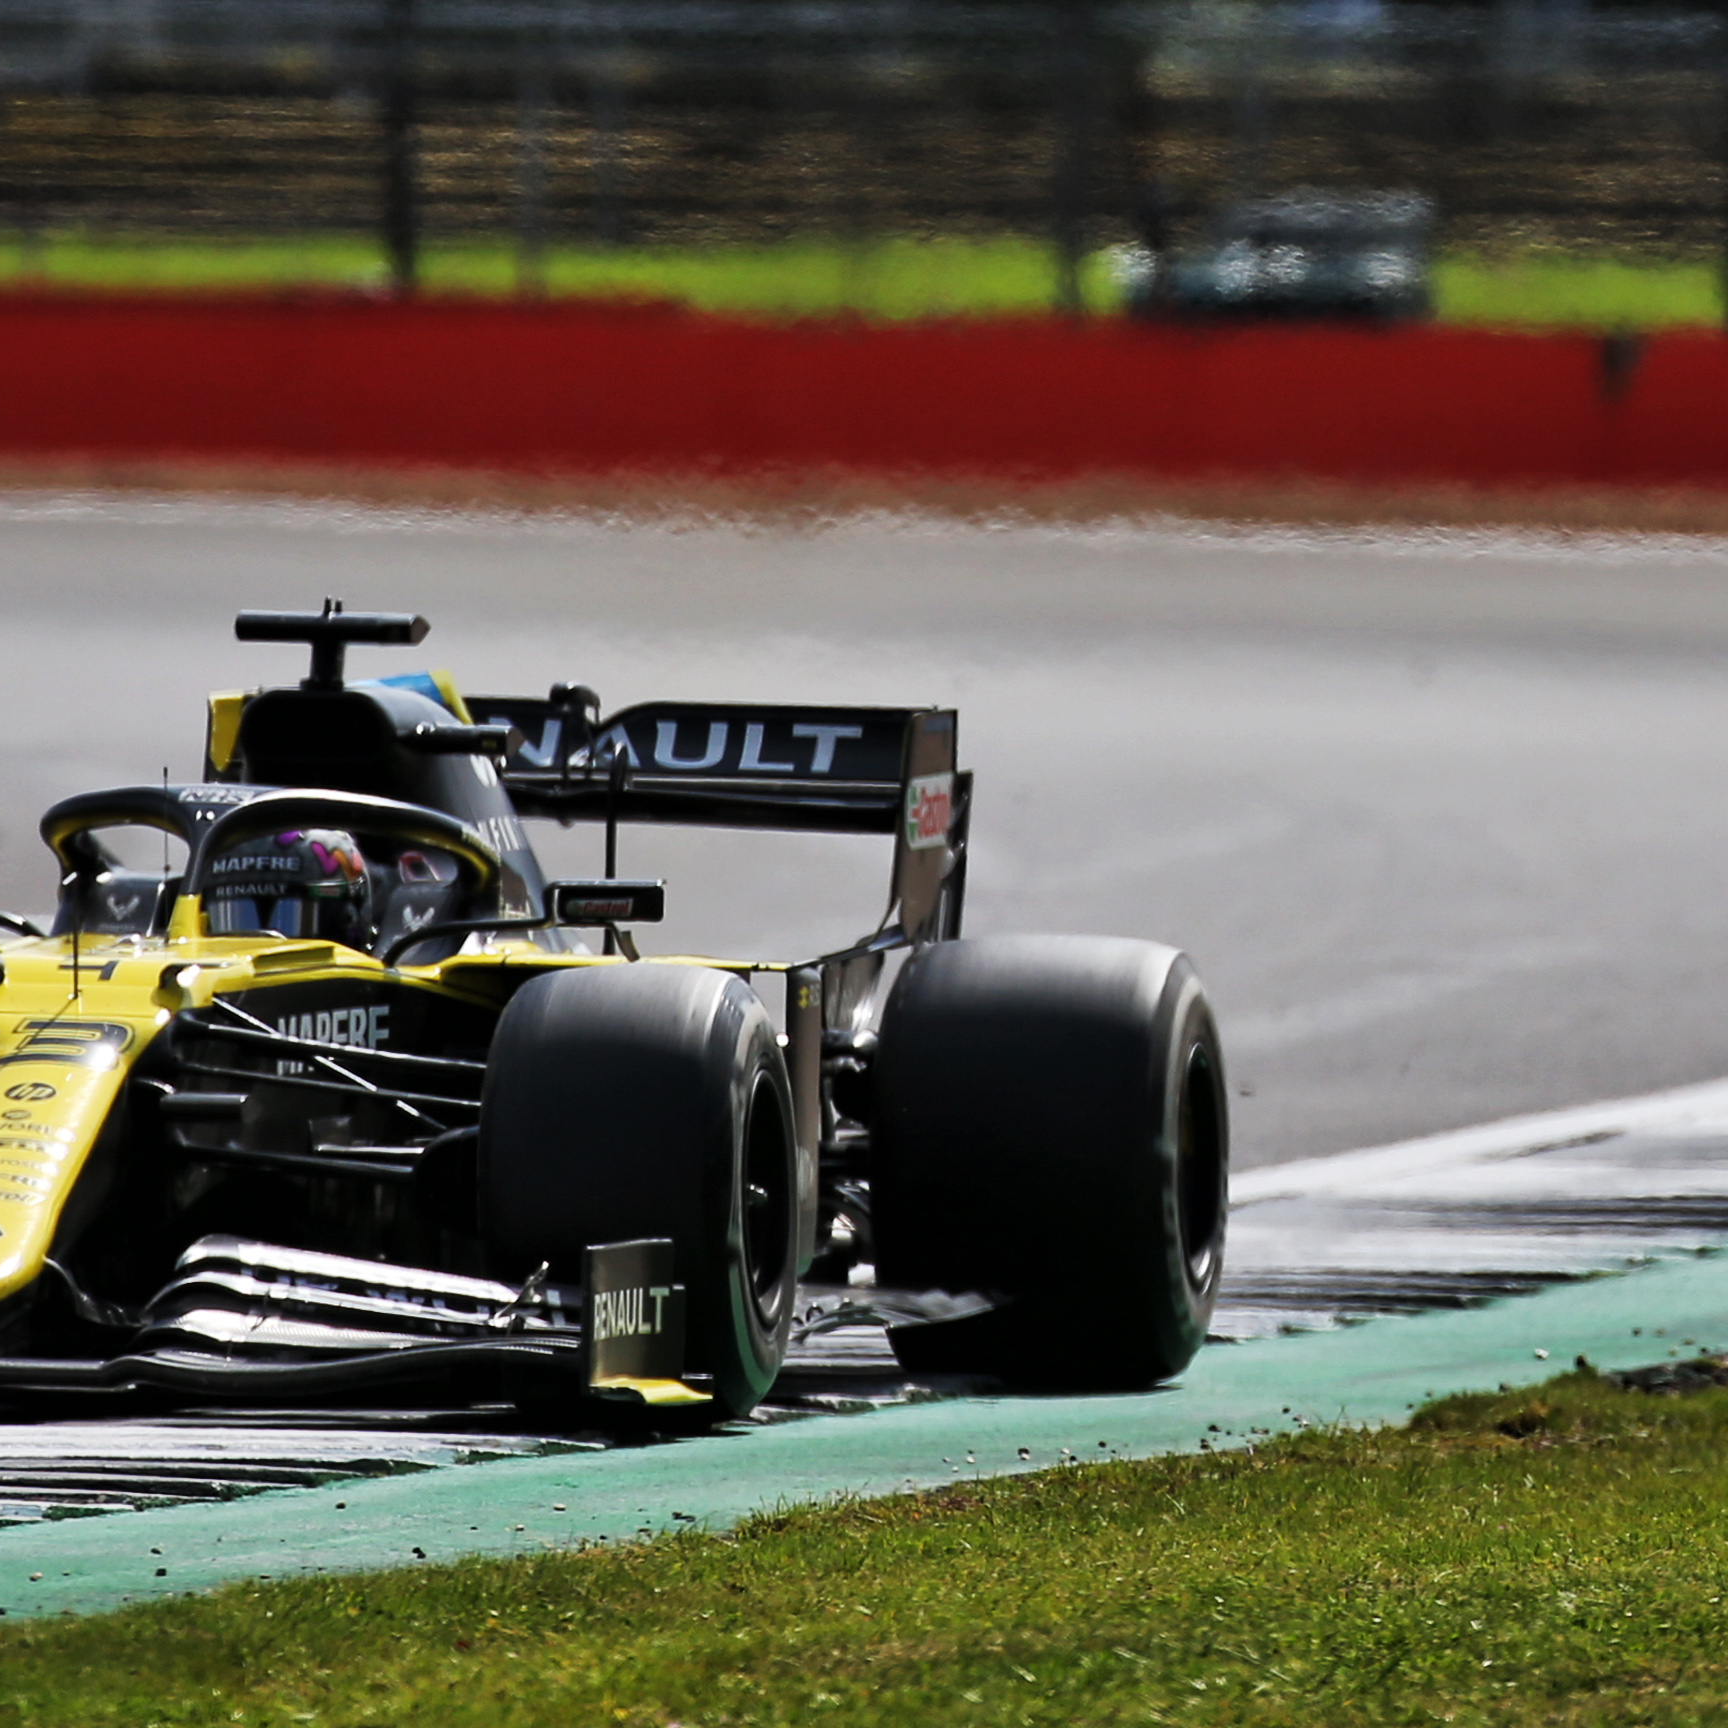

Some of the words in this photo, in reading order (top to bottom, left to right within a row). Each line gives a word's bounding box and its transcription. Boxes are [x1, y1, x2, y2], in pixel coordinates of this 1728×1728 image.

[212, 856, 299, 874] MAPFRE
[215, 882, 287, 898] RENAULT
[594, 1287, 670, 1341] RENAULT
